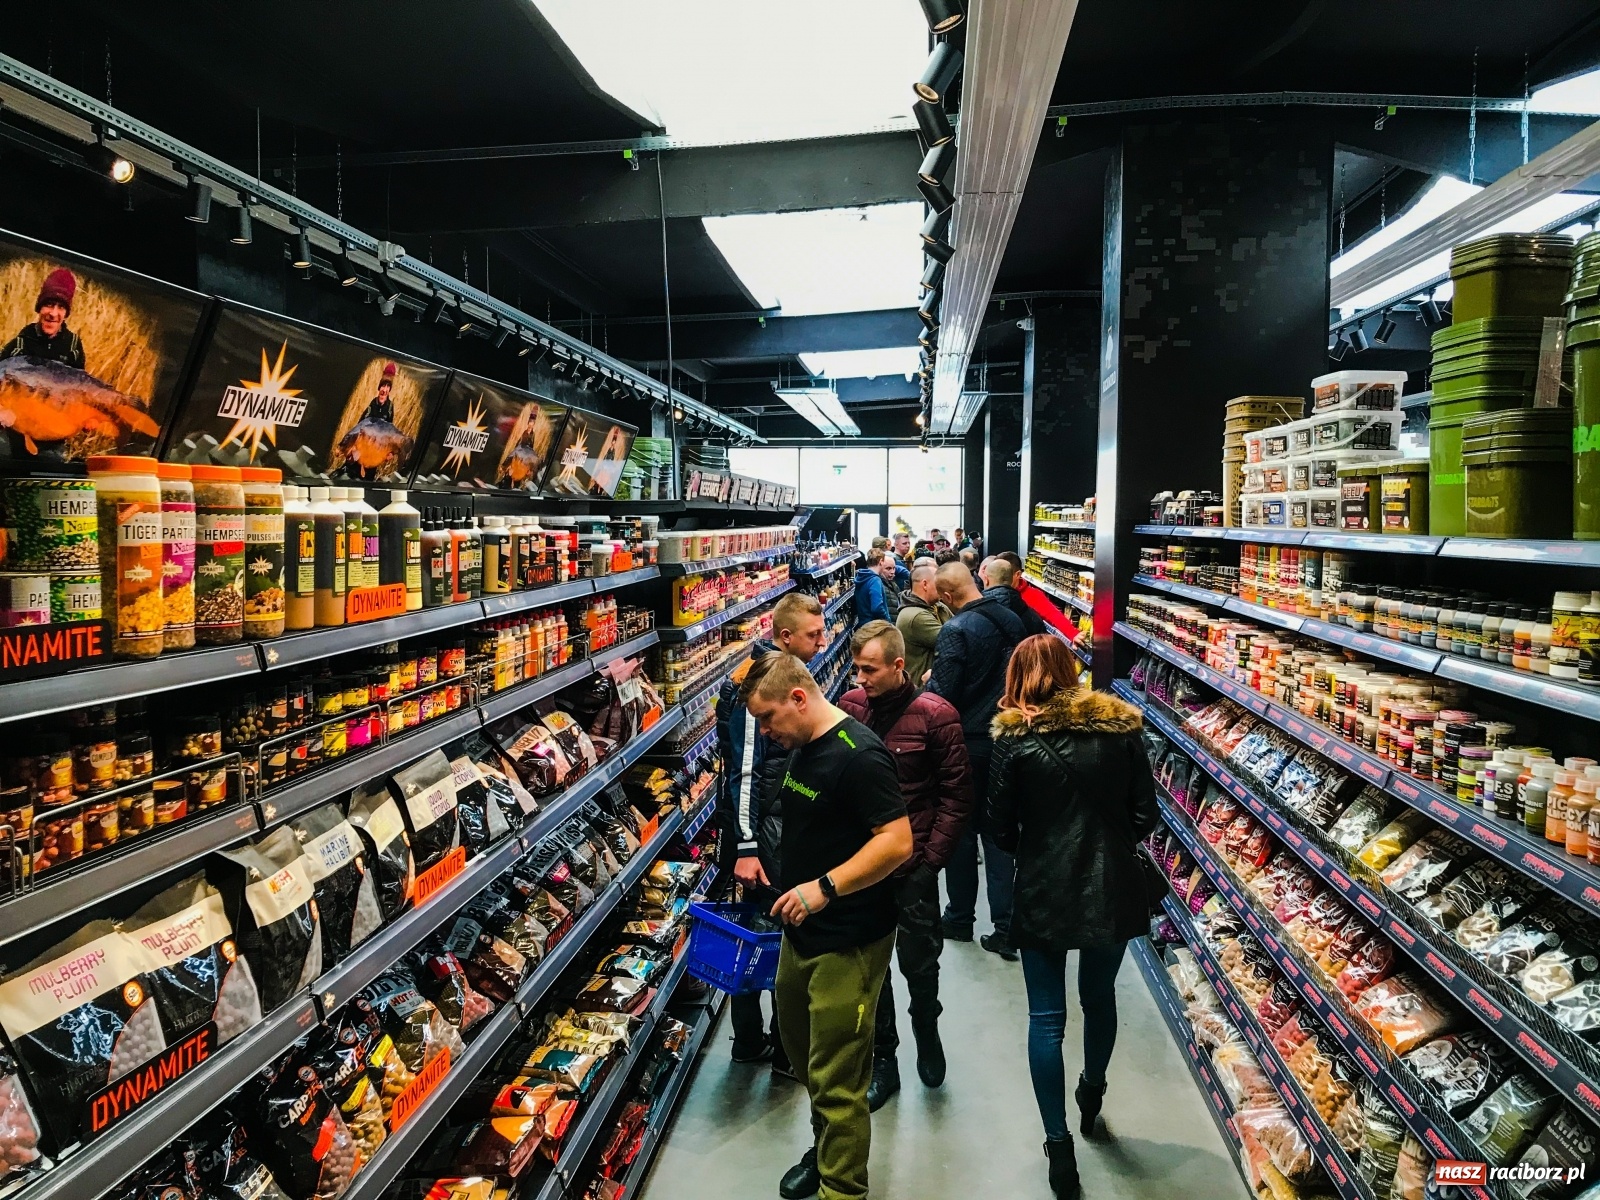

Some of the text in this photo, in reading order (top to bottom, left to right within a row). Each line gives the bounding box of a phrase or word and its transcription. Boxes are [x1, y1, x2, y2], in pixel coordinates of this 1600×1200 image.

[219, 388, 307, 425] DYNAMITE
[443, 427, 489, 451] DYNAMITE
[122, 525, 157, 540] TIGER
[353, 588, 402, 615] DYNAMITE
[0, 625, 103, 669] NAMITE
[320, 834, 349, 857] MARINE
[418, 851, 463, 899] DYNAMITE
[140, 914, 207, 950] MULBERRY
[162, 935, 202, 960] PLUM
[28, 949, 106, 996] MULBERRY
[53, 973, 99, 1004] PLUM
[92, 1030, 210, 1132] DYNAMITE
[397, 1052, 448, 1121] DYNAMITE
